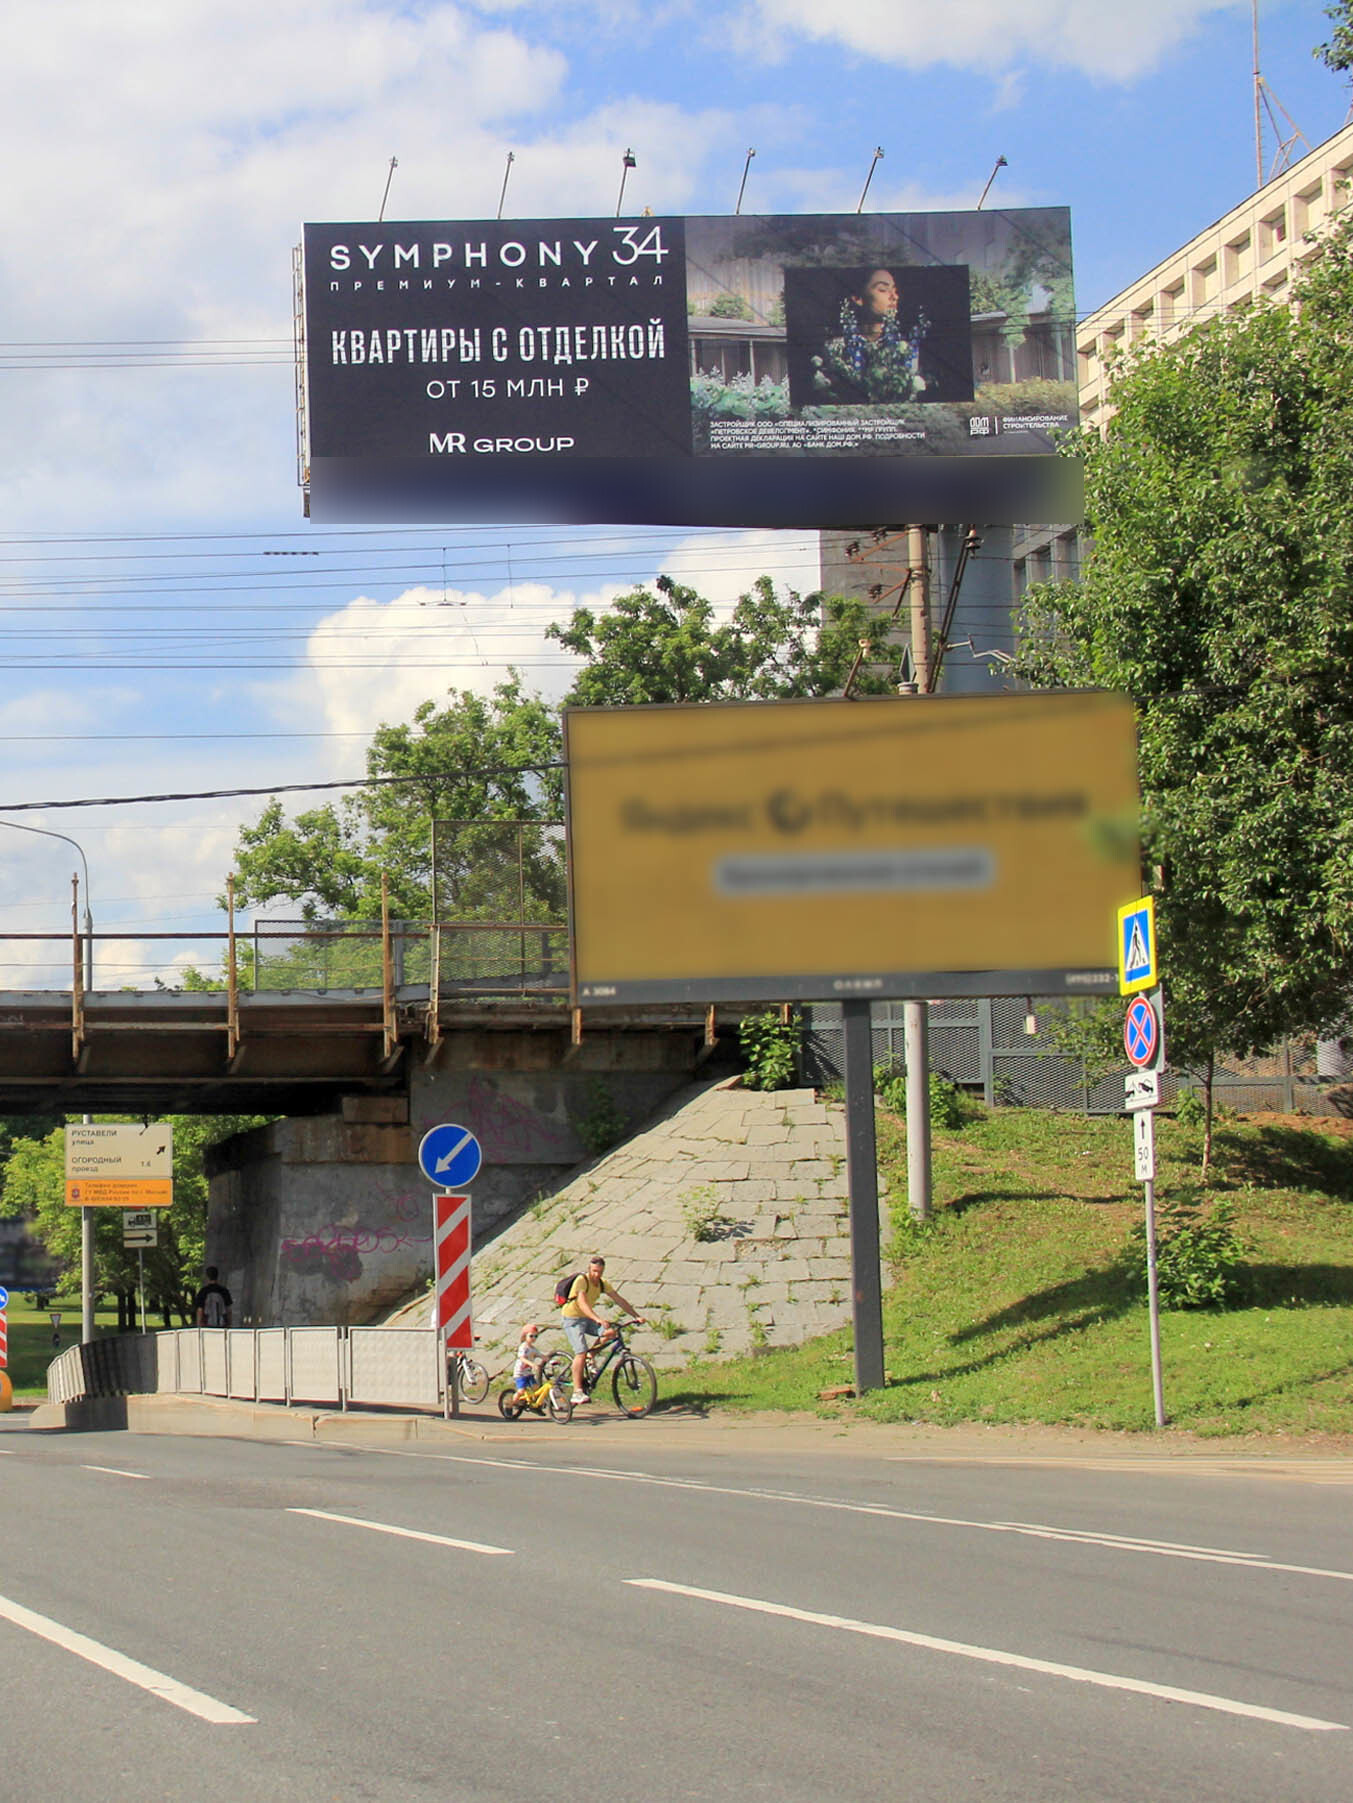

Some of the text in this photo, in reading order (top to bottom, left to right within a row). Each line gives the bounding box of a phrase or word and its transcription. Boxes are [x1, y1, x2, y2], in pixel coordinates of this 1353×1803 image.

[329, 225, 669, 271] SYMPHONY 34
[330, 275, 663, 291] ПРЕМИУМ-КВАРТАЛ
[331, 317, 665, 365] КВАРТИРЫ С ОТДЕЛКОЙ
[426, 380, 461, 399] ОТ
[470, 379, 496, 399] 15
[506, 378, 564, 398] МЛН
[428, 432, 575, 454] MR GROUP
[71, 1155, 121, 1163] ОГОРОДНЫЙ
[1137, 1146, 1149, 1161] 50
